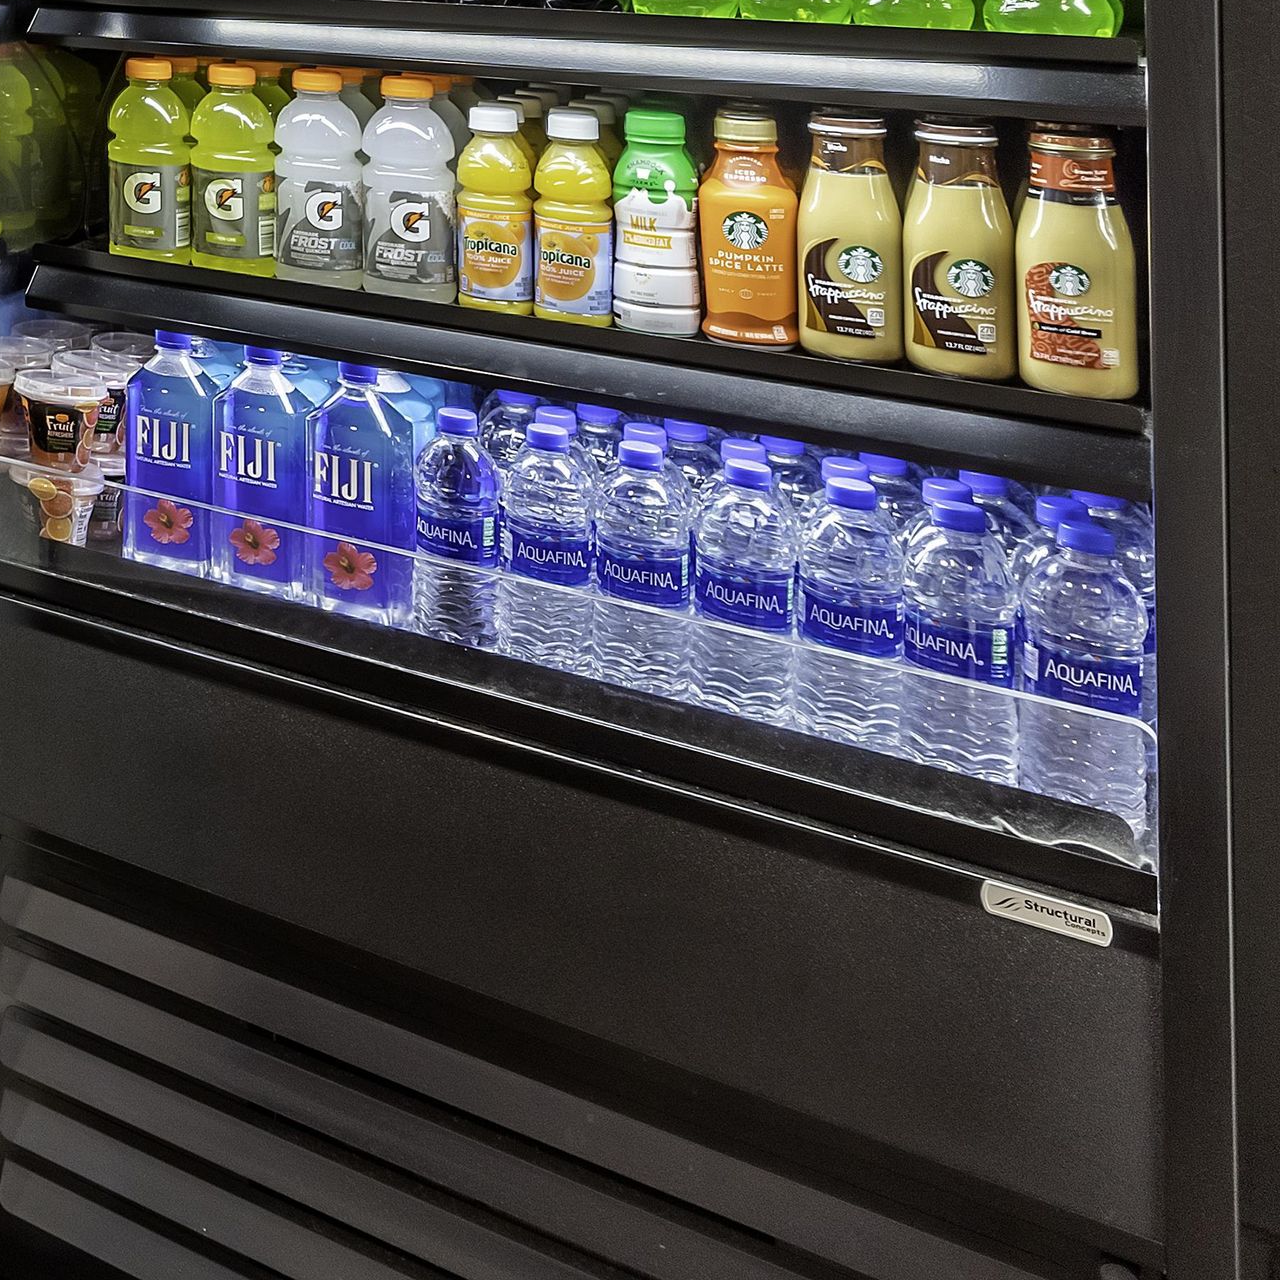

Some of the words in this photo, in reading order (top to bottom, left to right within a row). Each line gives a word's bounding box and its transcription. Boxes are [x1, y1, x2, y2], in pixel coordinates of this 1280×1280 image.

[123, 172, 162, 214] G
[723, 172, 767, 183] ESPRESSO
[204, 178, 244, 221] G
[305, 191, 342, 231] G
[390, 201, 431, 242] G
[629, 214, 657, 232] MILK
[464, 236, 518, 257] Tropicana
[717, 249, 774, 263] PUMPKIN
[708, 257, 742, 271] SPICE
[746, 262, 784, 272] LATTE
[45, 416, 75, 434] Fruit
[136, 415, 190, 462] FIJI
[219, 431, 277, 482] FIJI
[313, 451, 373, 504] FIJI
[517, 541, 587, 568] AQUAFINA
[603, 560, 679, 590] AQUAFINA
[705, 580, 784, 615] AQUAFINA
[810, 604, 894, 639] AQUAFINA
[904, 622, 985, 667] AQUAFINA
[1044, 660, 1138, 697] AQUAFINA
[1023, 899, 1097, 929] Structural
[1064, 920, 1106, 938] Concepts
